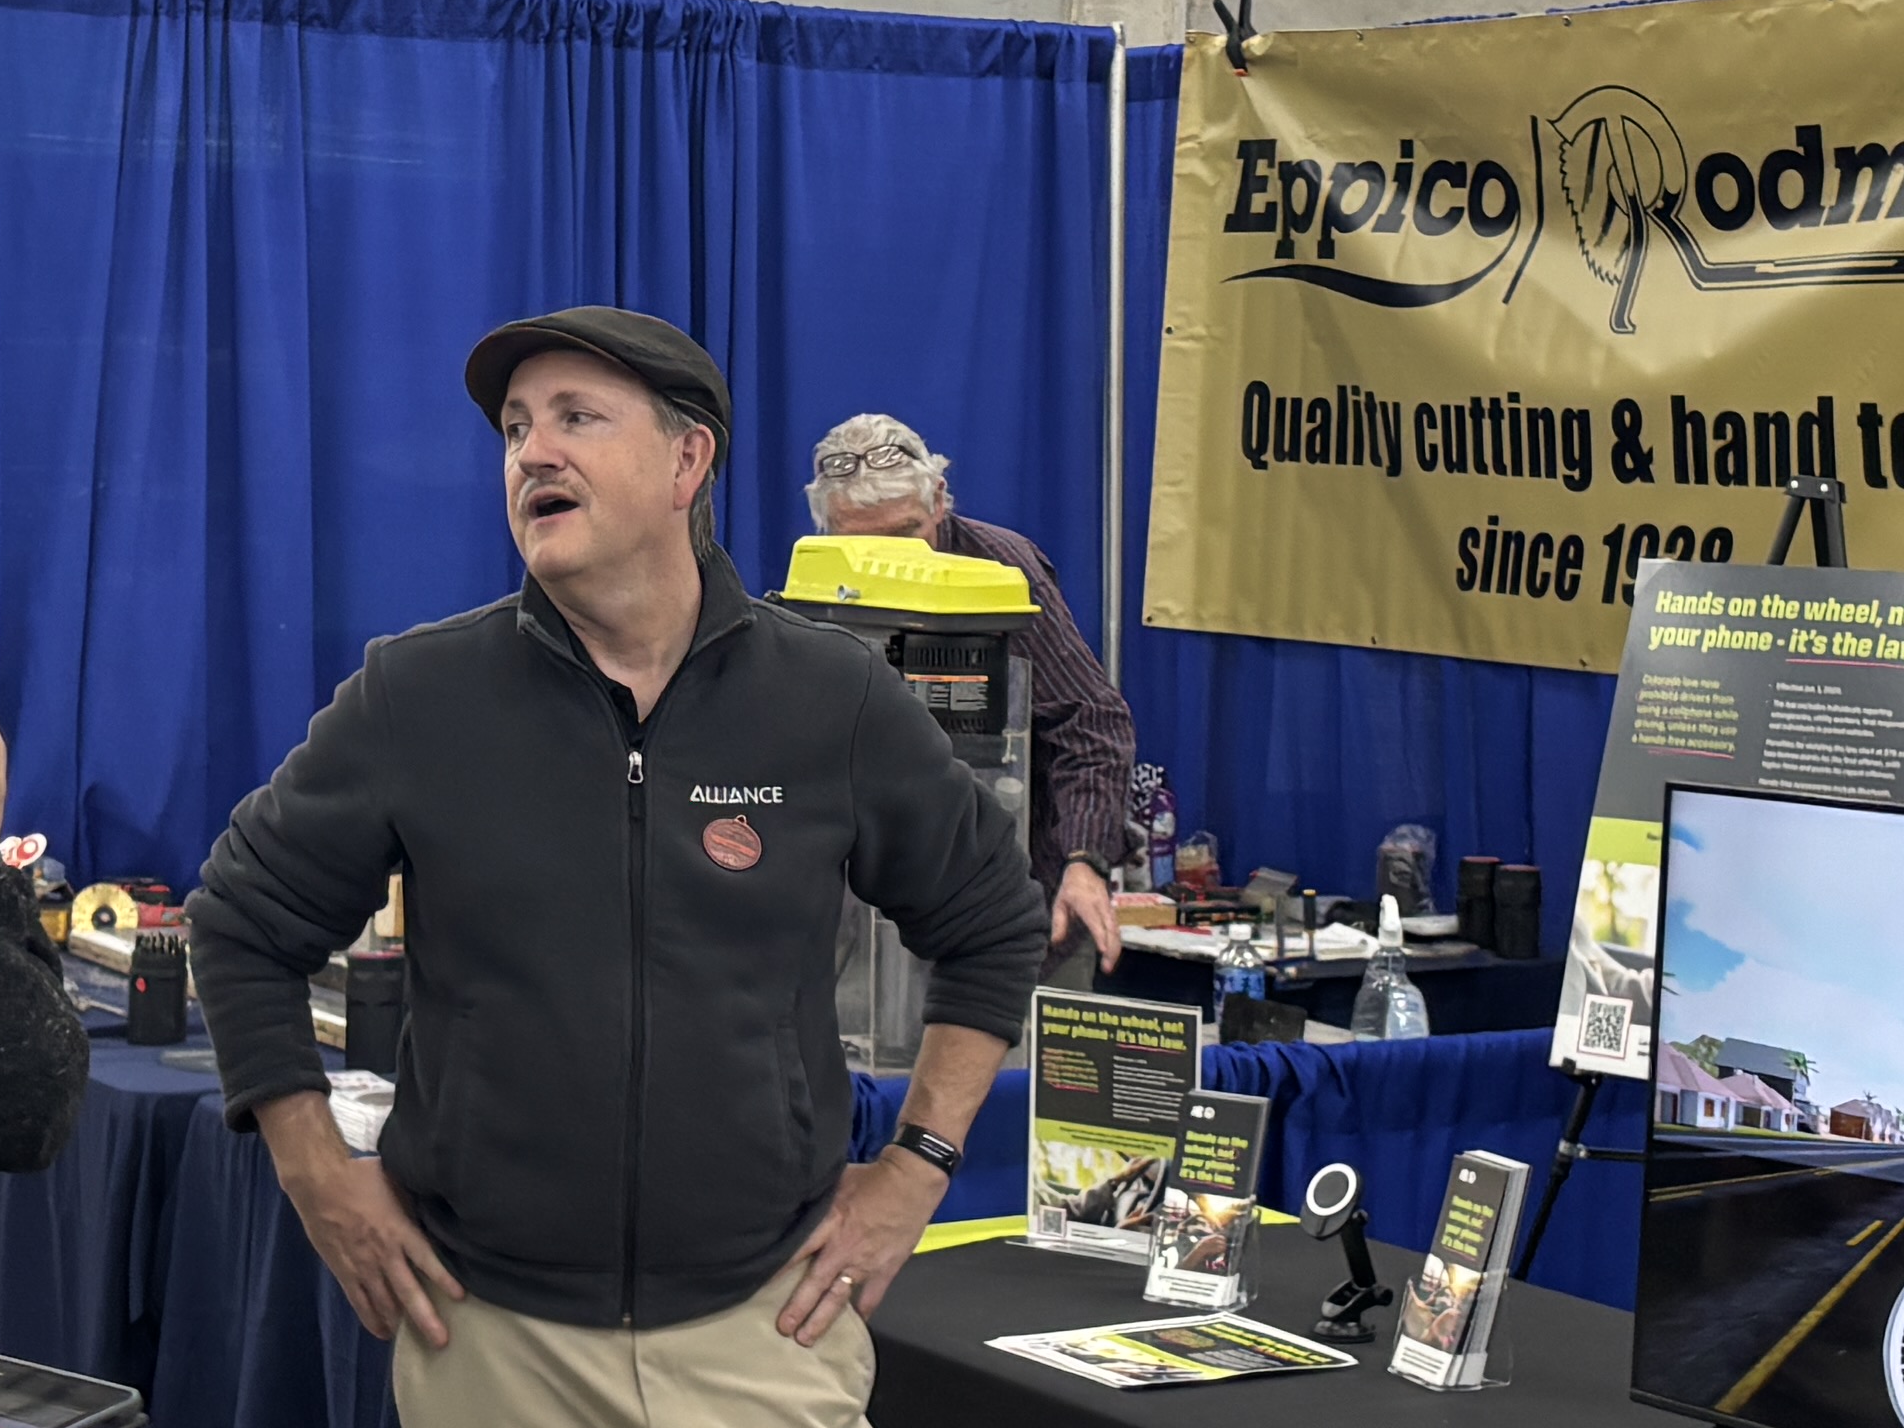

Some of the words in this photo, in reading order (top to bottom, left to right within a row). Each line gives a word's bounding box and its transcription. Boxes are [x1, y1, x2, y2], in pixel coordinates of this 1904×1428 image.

[1223, 138, 1520, 260] Eppico
[1240, 380, 1401, 478] Quality
[1414, 391, 1592, 492] cutting
[1610, 398, 1654, 485] &
[1672, 394, 1837, 488] hand
[1457, 514, 1586, 604] since
[1648, 625, 1702, 651] your
[1701, 623, 1774, 653] phone
[1788, 628, 1828, 656] it's
[1831, 630, 1873, 658] the
[1655, 590, 1725, 616] Hands
[1727, 597, 1757, 618] on
[1760, 594, 1800, 620] the
[1803, 597, 1883, 628] wheel,
[690, 785, 784, 804] ALLIANCE
